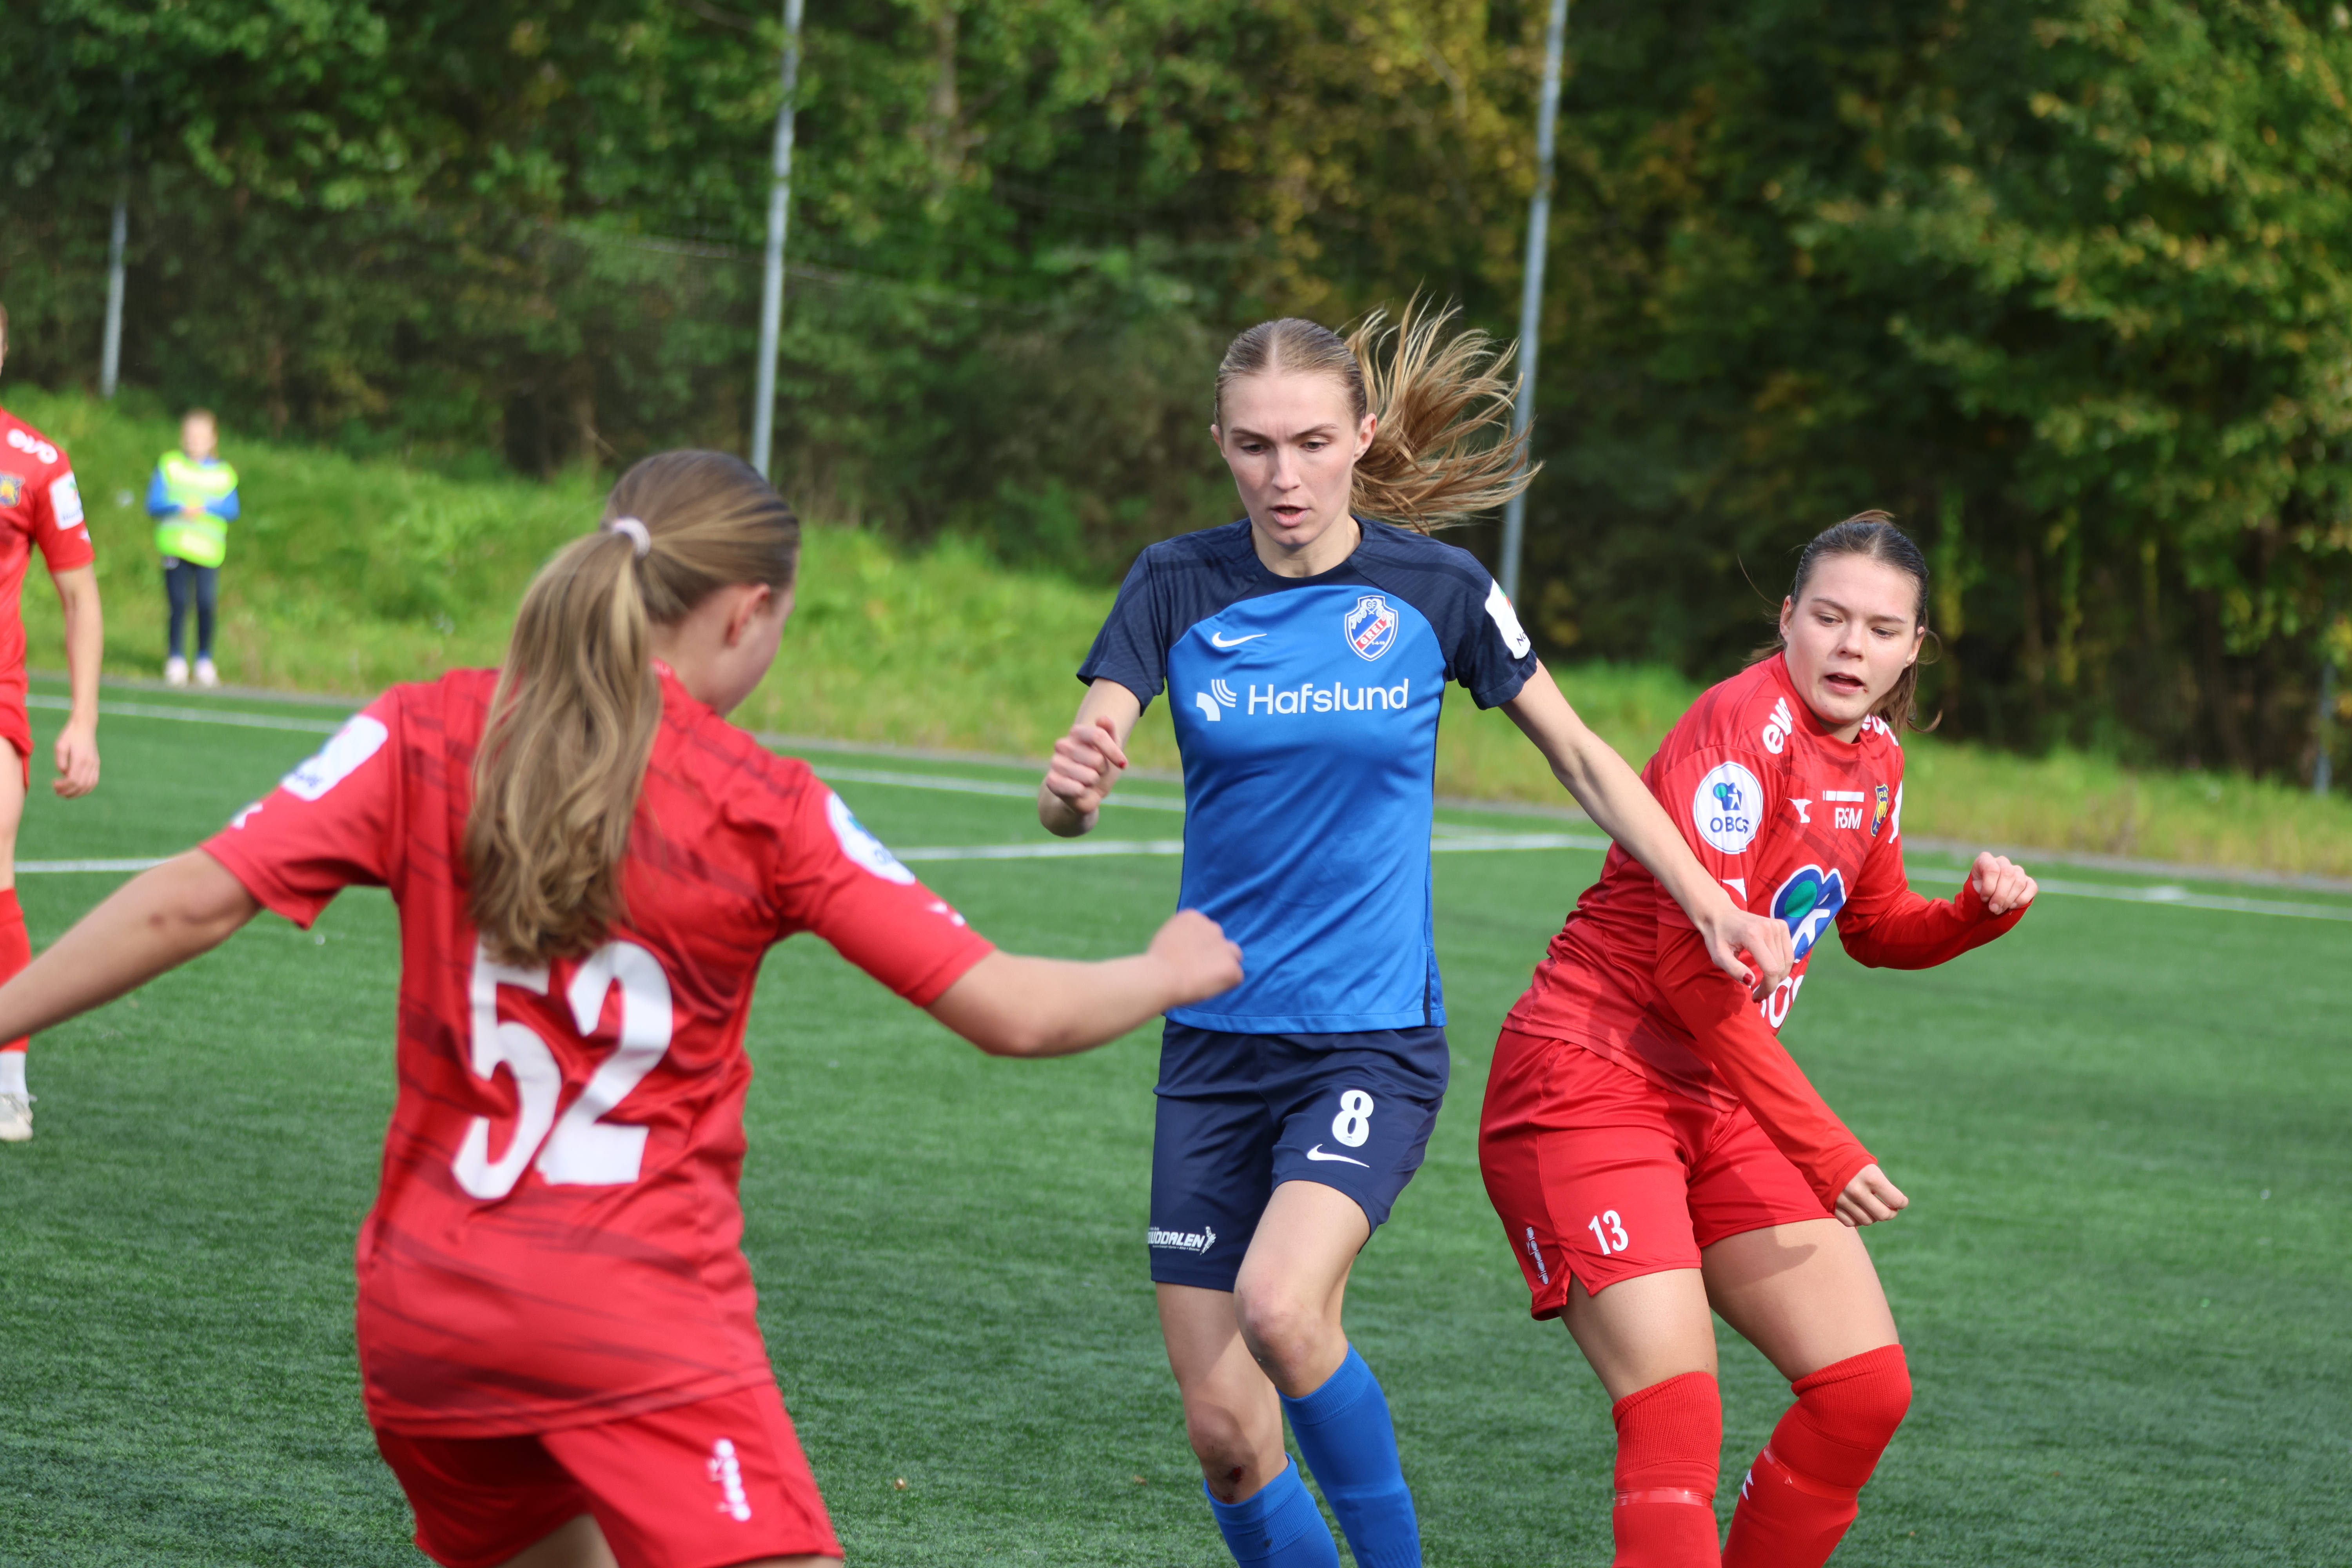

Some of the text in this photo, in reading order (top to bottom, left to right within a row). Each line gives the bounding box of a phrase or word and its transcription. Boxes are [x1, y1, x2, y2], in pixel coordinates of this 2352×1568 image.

[1359, 622, 1384, 644] GREI
[1248, 679, 1409, 715] Hafslund
[1835, 808, 1863, 829] RSM
[452, 929, 673, 1200] 52
[1332, 1090, 1374, 1147] 8
[1588, 1210, 1629, 1255] 13
